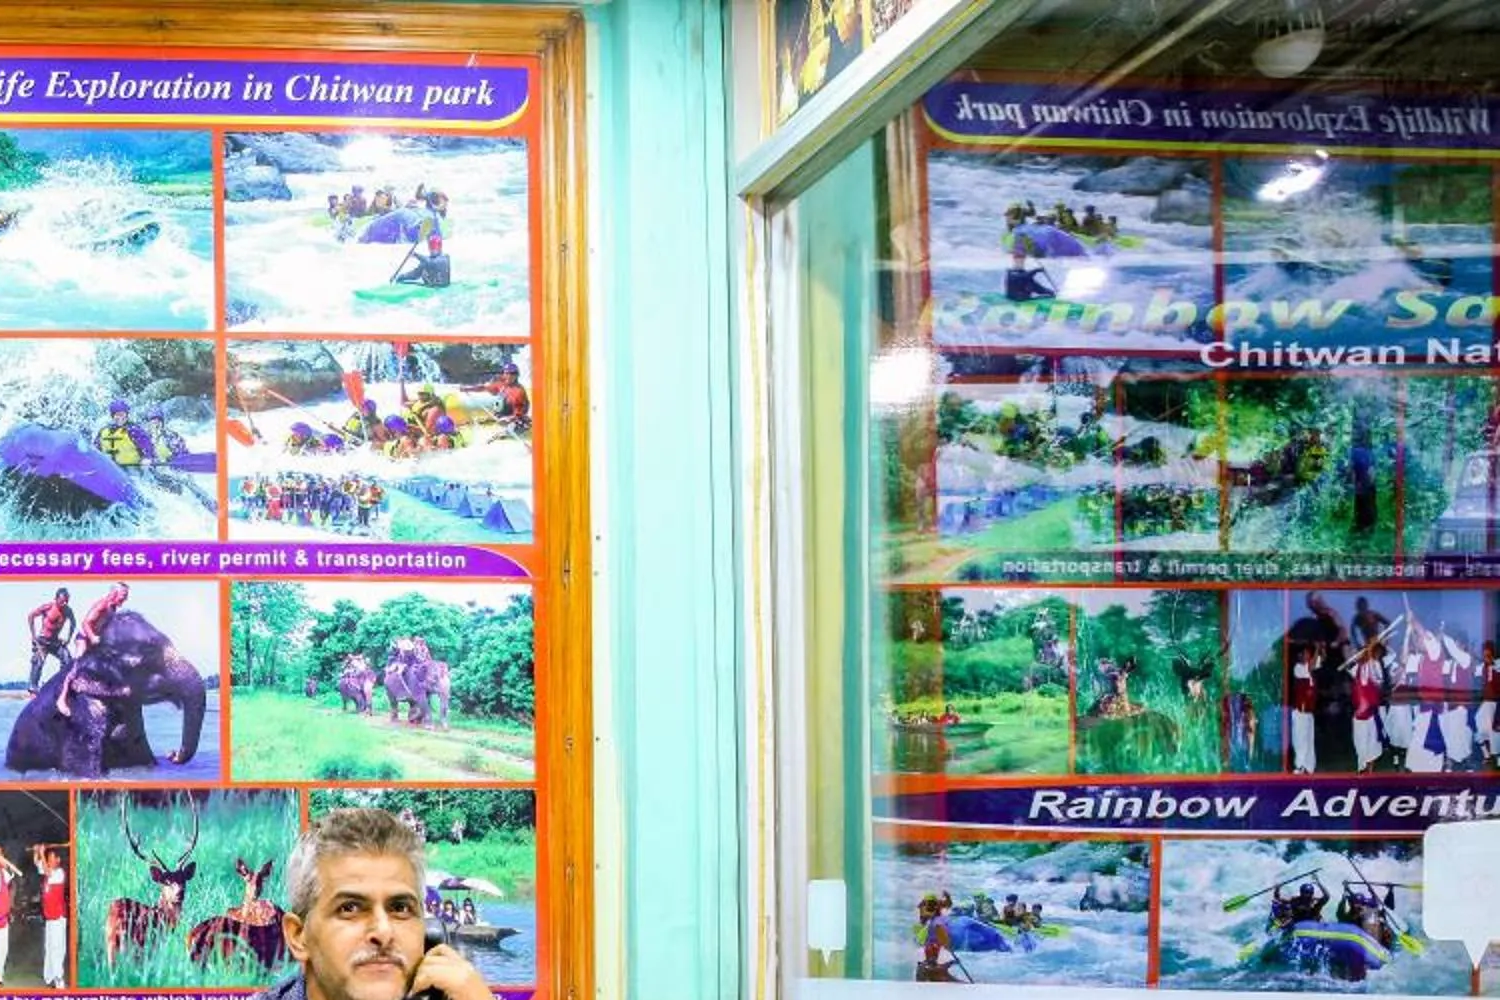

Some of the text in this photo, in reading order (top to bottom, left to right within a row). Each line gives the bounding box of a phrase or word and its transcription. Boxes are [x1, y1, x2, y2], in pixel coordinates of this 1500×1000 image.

[46, 69, 232, 106] Exploration
[243, 72, 274, 101] in
[284, 72, 413, 105] Chitwan
[422, 78, 496, 110] park
[920, 286, 1352, 330] Rainbow
[1200, 340, 1404, 368] Chitwan
[102, 549, 154, 570] fees,
[161, 549, 211, 566] river
[219, 550, 287, 573] permit
[294, 551, 310, 568] &
[317, 551, 467, 572] transportation
[1028, 790, 1257, 819] Rainbow
